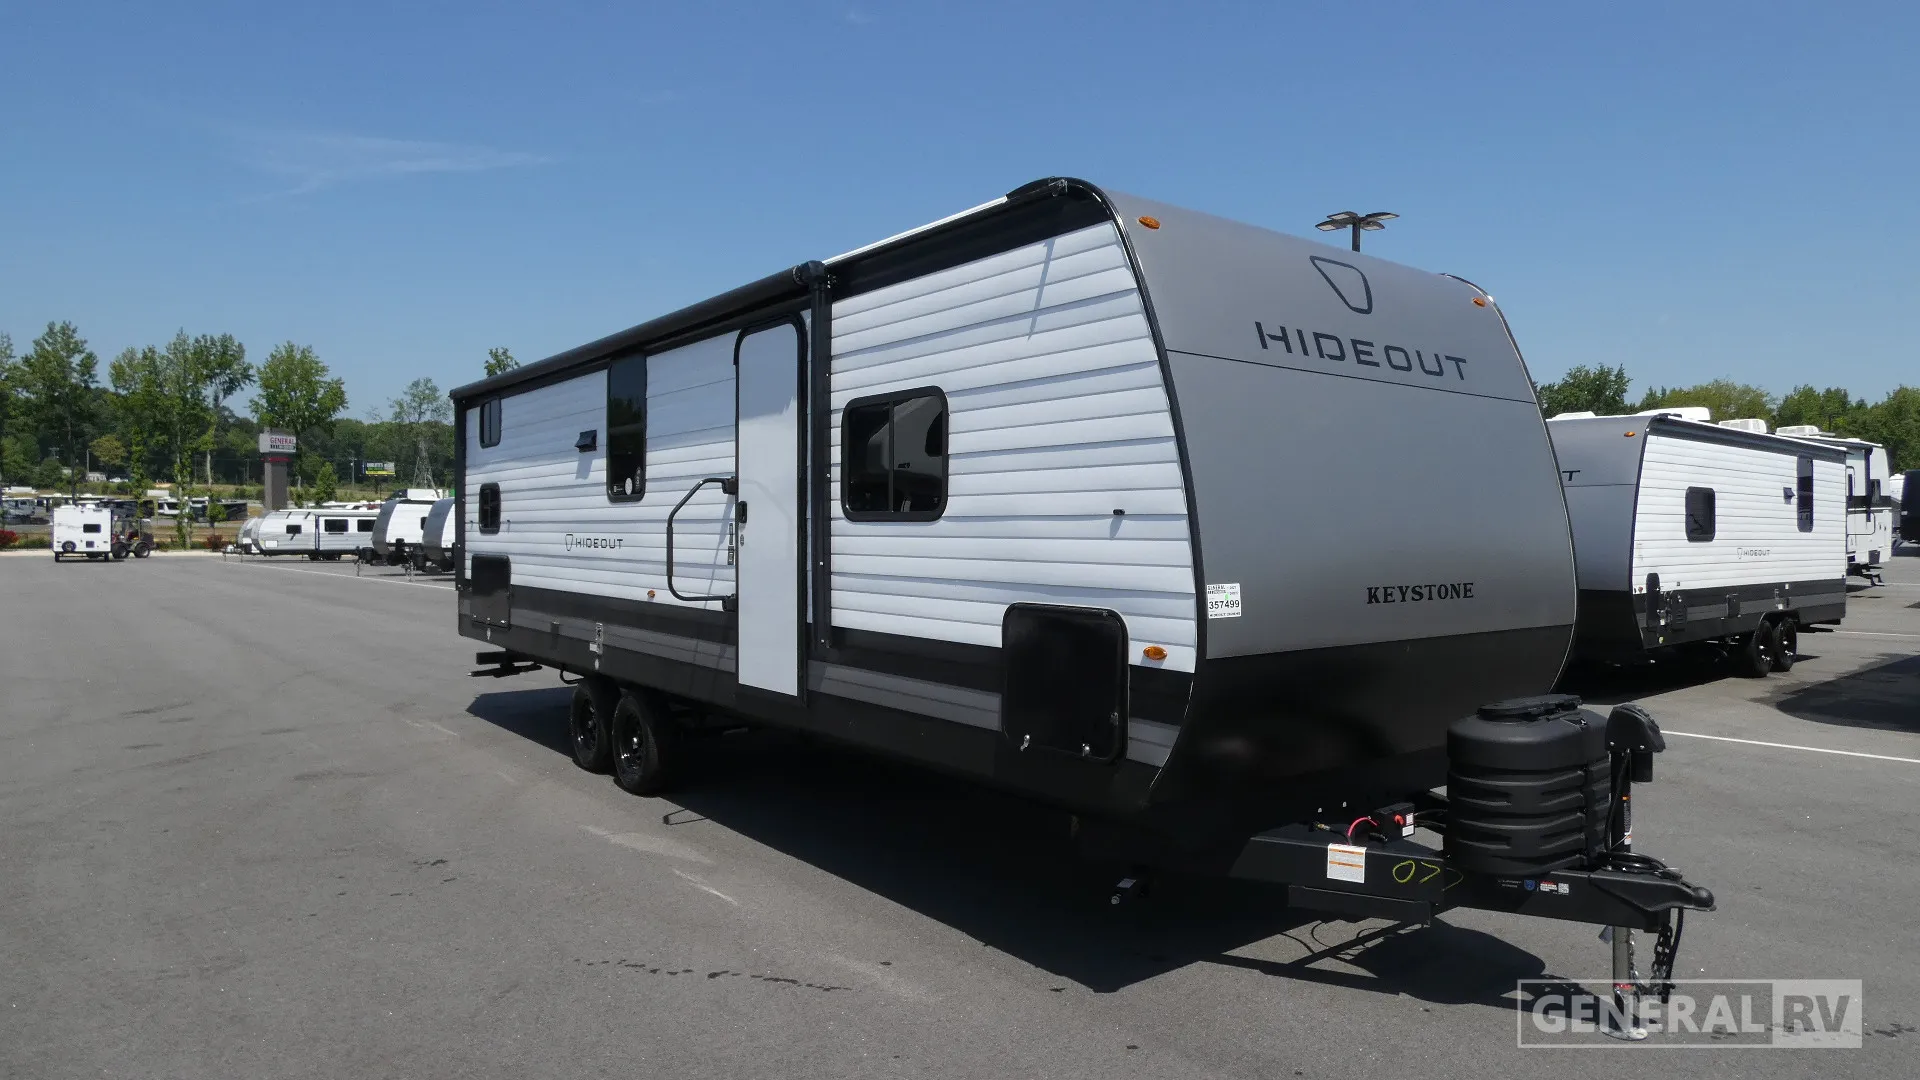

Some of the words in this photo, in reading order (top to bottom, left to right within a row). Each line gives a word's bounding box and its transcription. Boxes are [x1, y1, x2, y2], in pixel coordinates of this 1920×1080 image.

[1254, 321, 1467, 381] HIDEOUT
[575, 537, 624, 549] HIDEOUT
[1743, 549, 1771, 557] HIDEOUT
[1366, 582, 1475, 604] KEYSTONE
[1208, 599, 1240, 610] 357499
